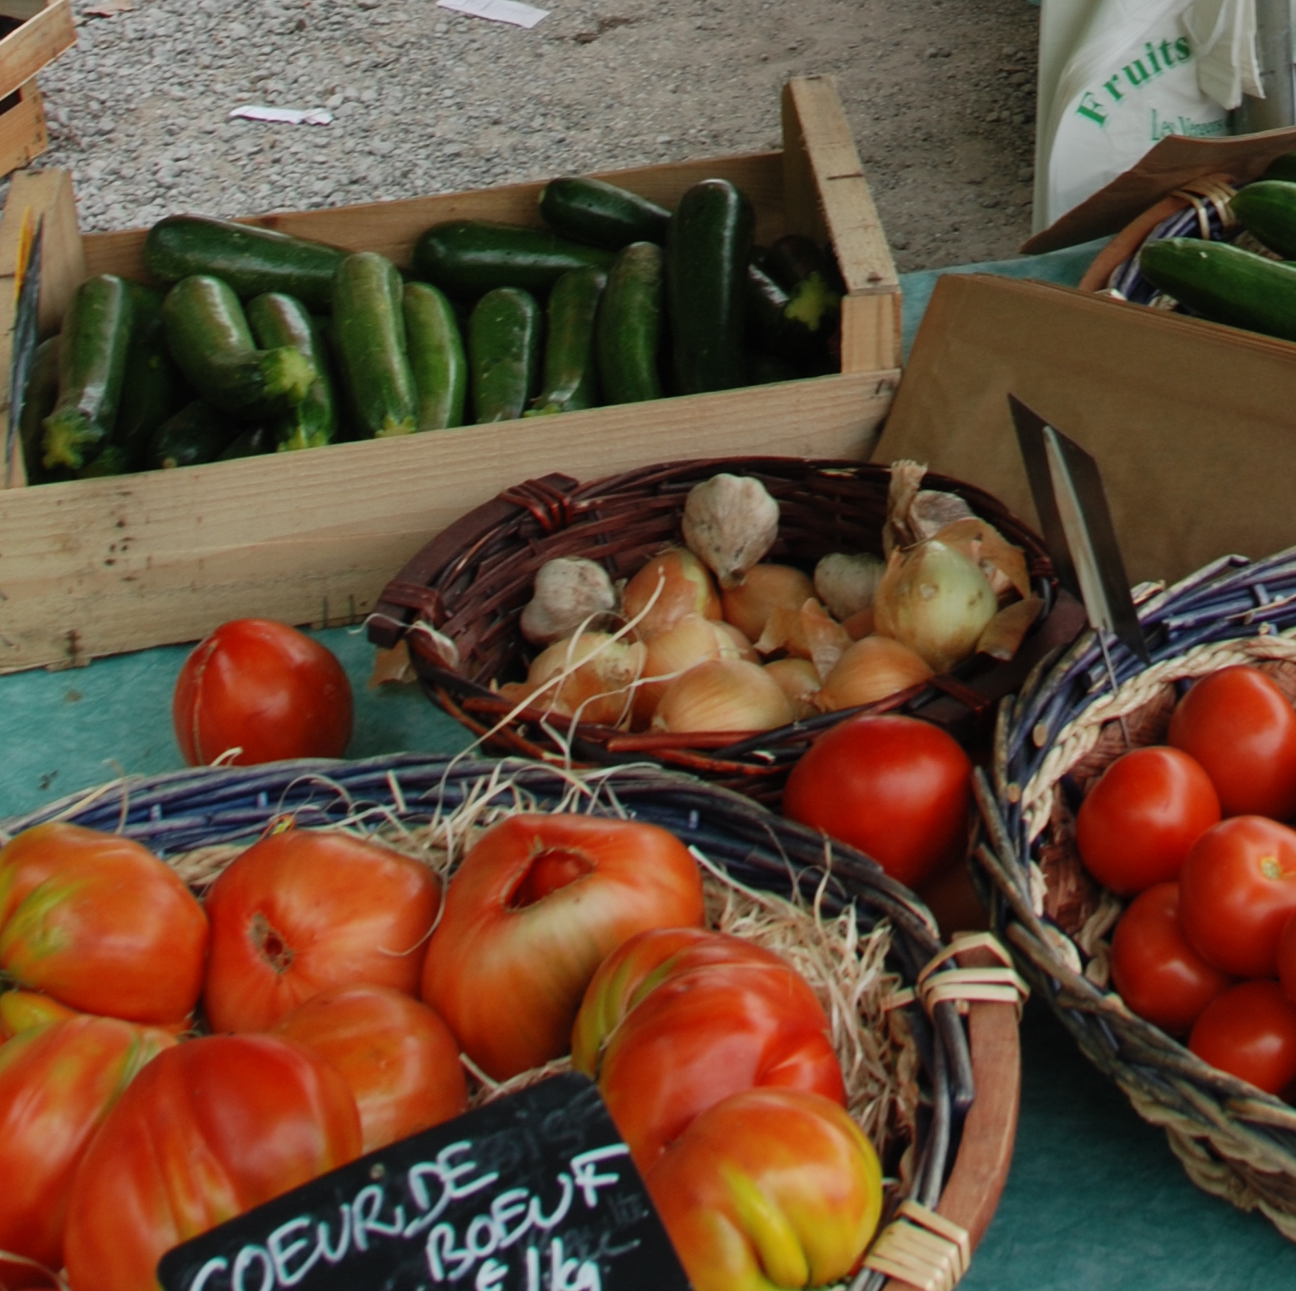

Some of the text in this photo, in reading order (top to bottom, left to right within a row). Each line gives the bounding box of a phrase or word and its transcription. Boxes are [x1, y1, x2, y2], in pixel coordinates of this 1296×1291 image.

[1076, 36, 1192, 128] Fruits
[187, 1140, 498, 1291] COEUR DE
[426, 1143, 629, 1281] BOEUF
